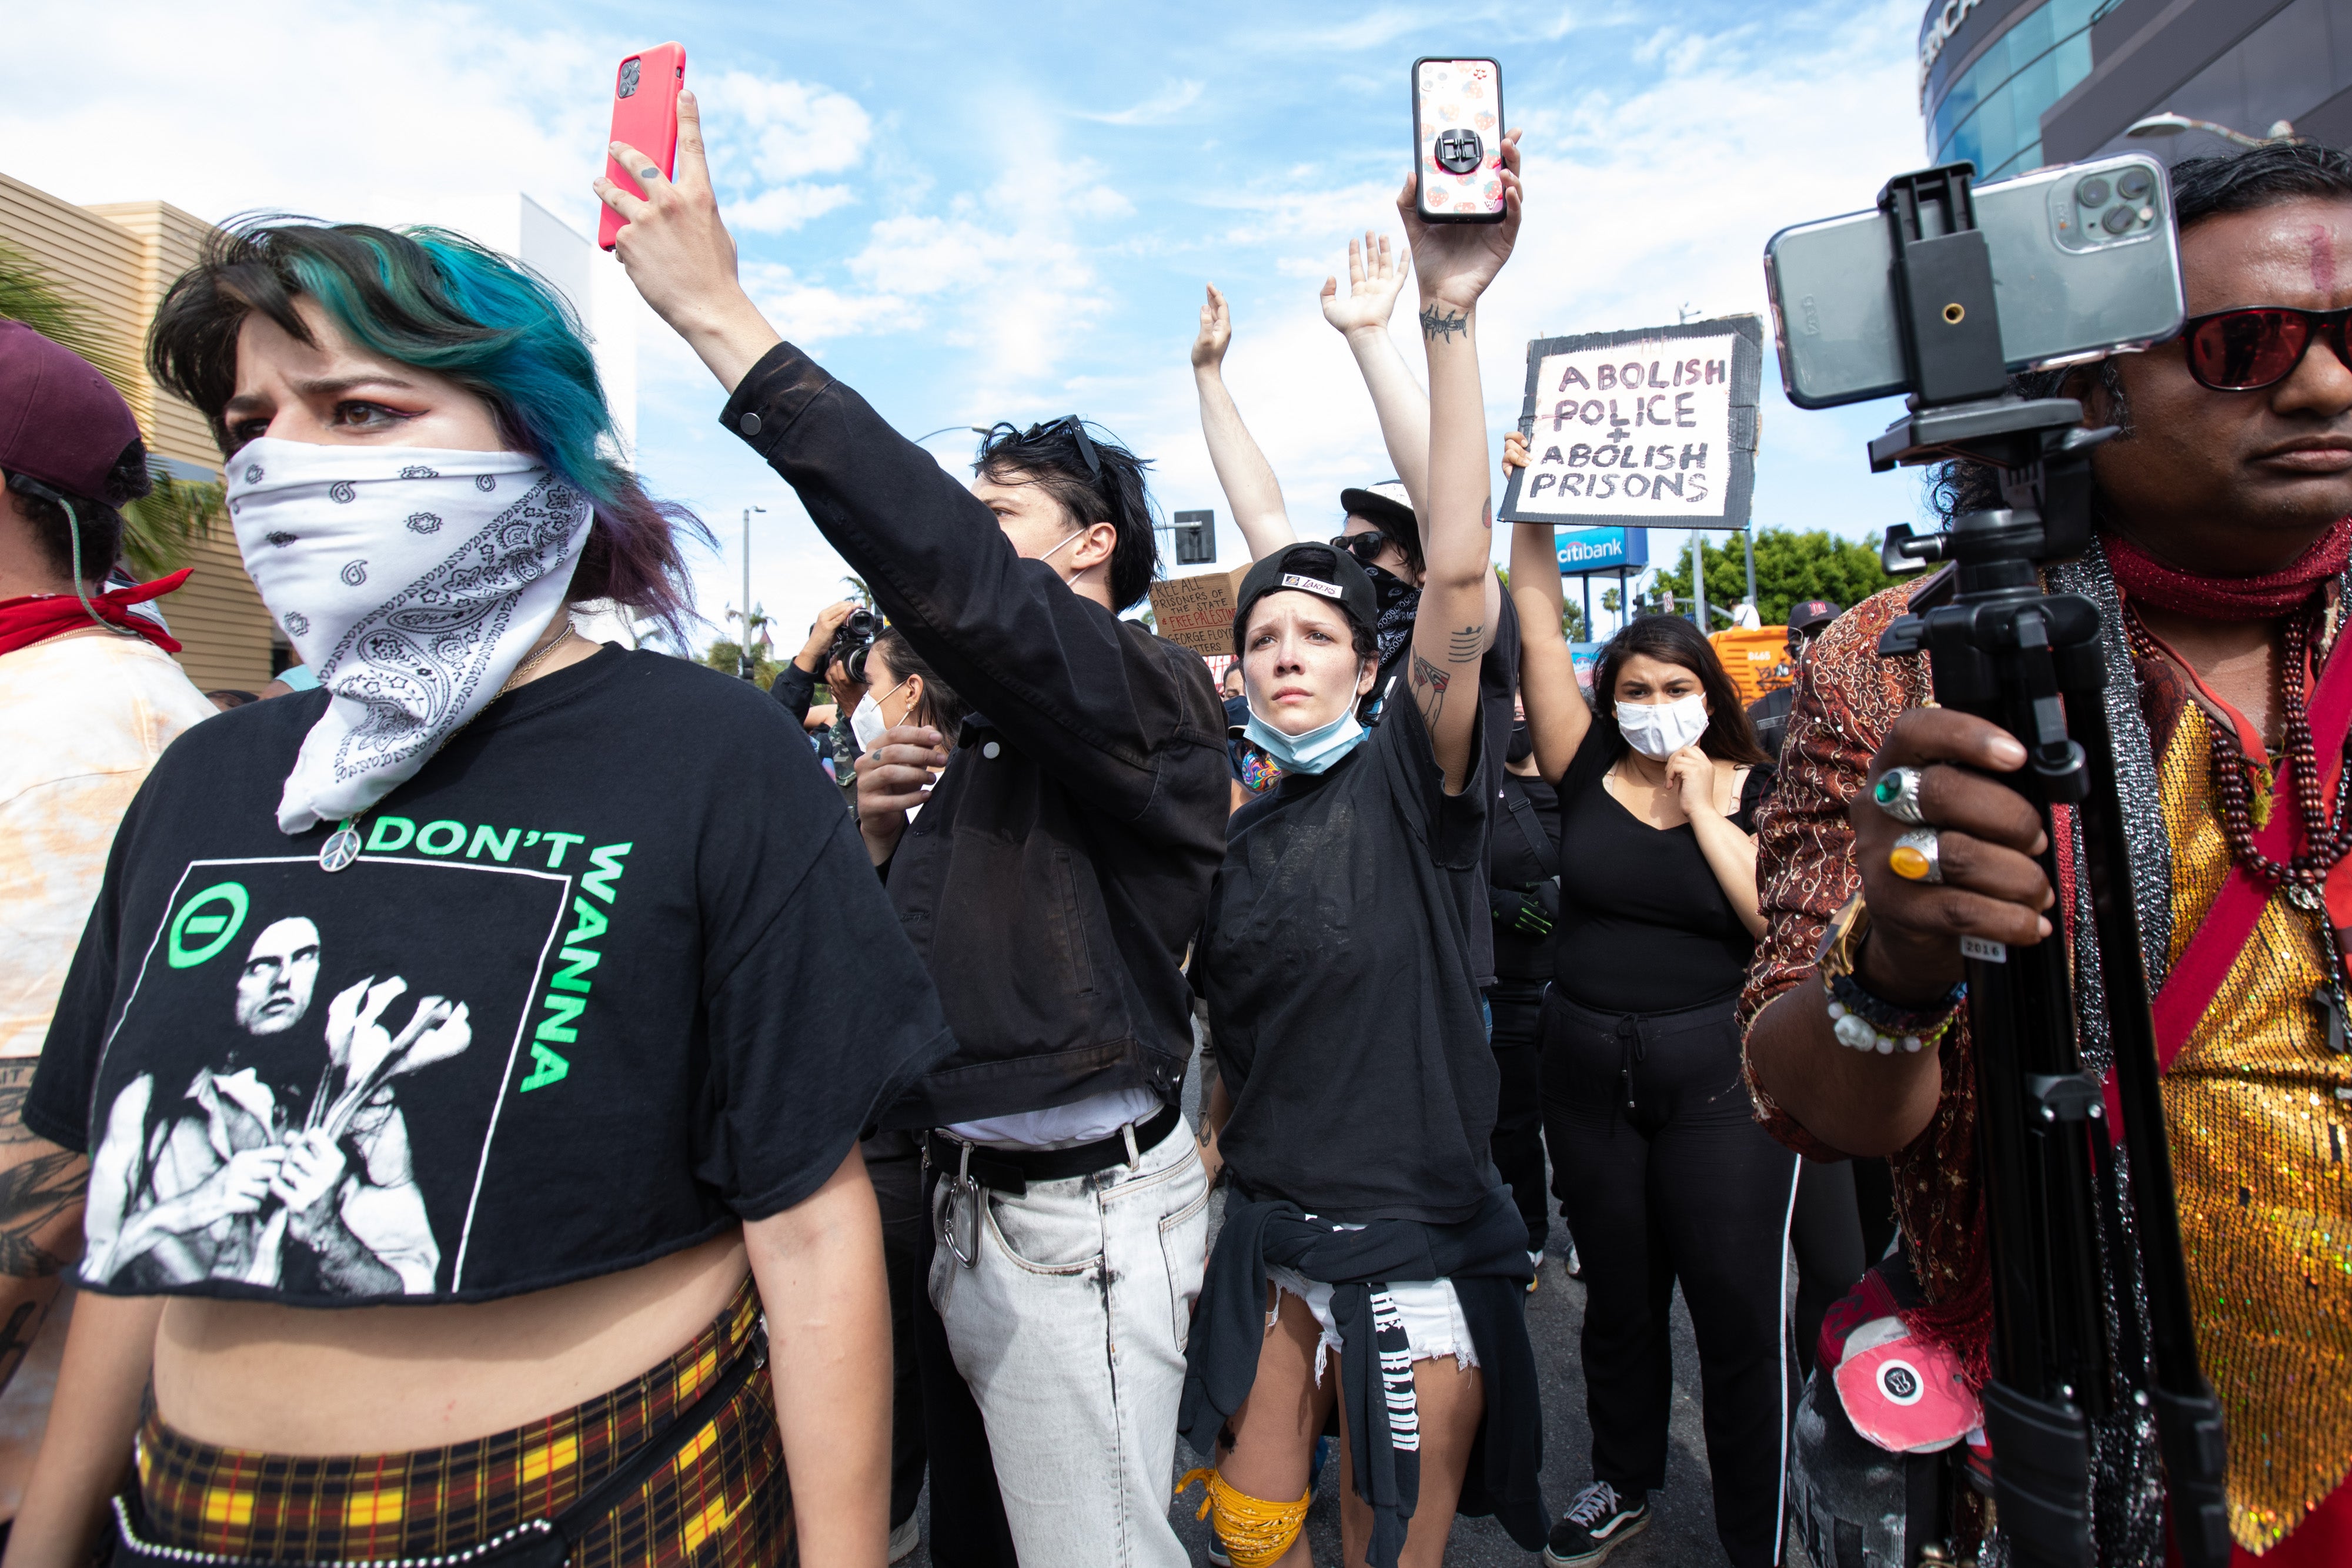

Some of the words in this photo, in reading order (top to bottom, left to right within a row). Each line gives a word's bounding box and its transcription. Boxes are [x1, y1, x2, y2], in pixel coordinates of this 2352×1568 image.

[1559, 359, 1725, 392] ABOLISH
[1553, 392, 1696, 432] POLICE
[1606, 427, 1631, 443] +
[1540, 442, 1708, 470] ABOLISH
[1529, 472, 1708, 502] PRISONS
[1557, 538, 1622, 563] citibank
[1182, 578, 1204, 593] ALL
[1153, 592, 1208, 610] PRISONERS
[1212, 589, 1223, 598] OF
[1171, 604, 1189, 615] THE
[1197, 599, 1228, 611] STATE
[1169, 613, 1195, 628] FREE
[1168, 631, 1206, 645] GEORGE
[365, 816, 585, 868] DON'T
[1966, 941, 2000, 957] 2016
[520, 842, 633, 1093] WANNA
